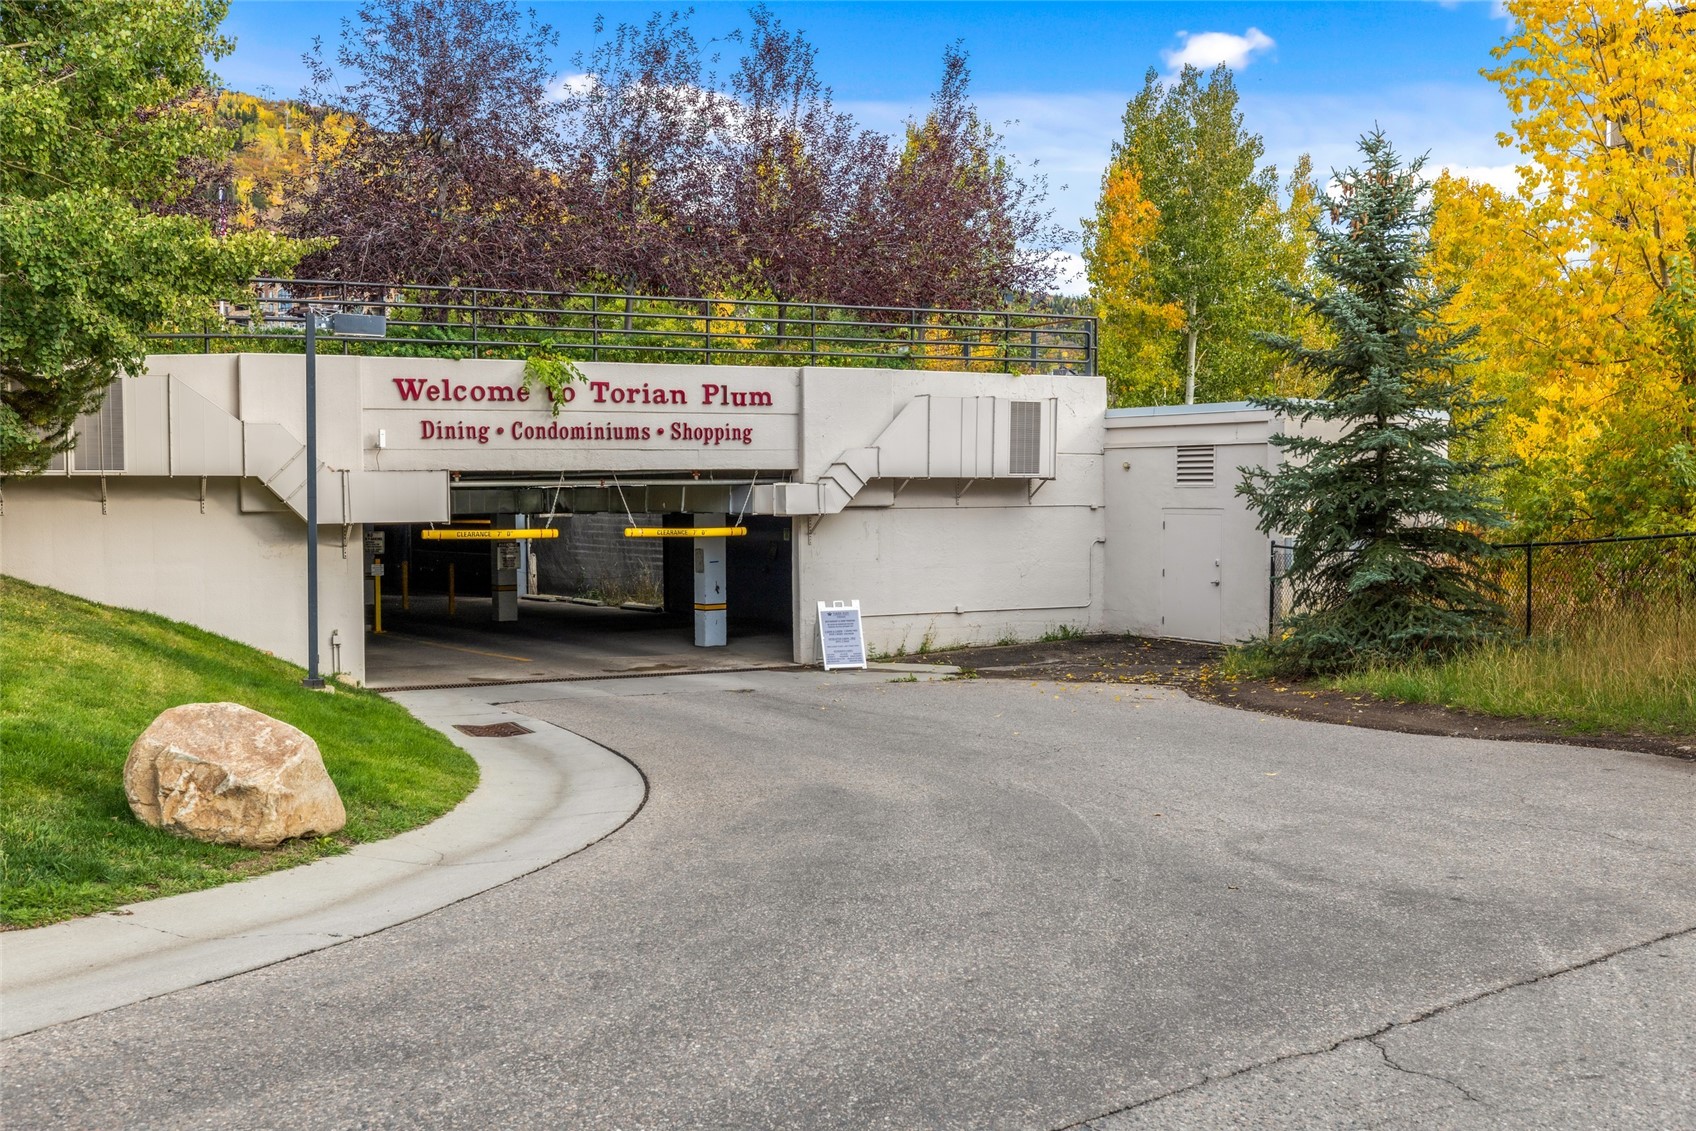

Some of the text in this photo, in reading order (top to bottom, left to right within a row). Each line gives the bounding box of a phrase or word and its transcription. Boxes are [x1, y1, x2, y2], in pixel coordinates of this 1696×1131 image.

[392, 377, 531, 402] Welcome
[590, 381, 688, 405] Torian
[701, 383, 774, 407] Plum
[420, 420, 753, 445] Dining Condominiums Shopping
